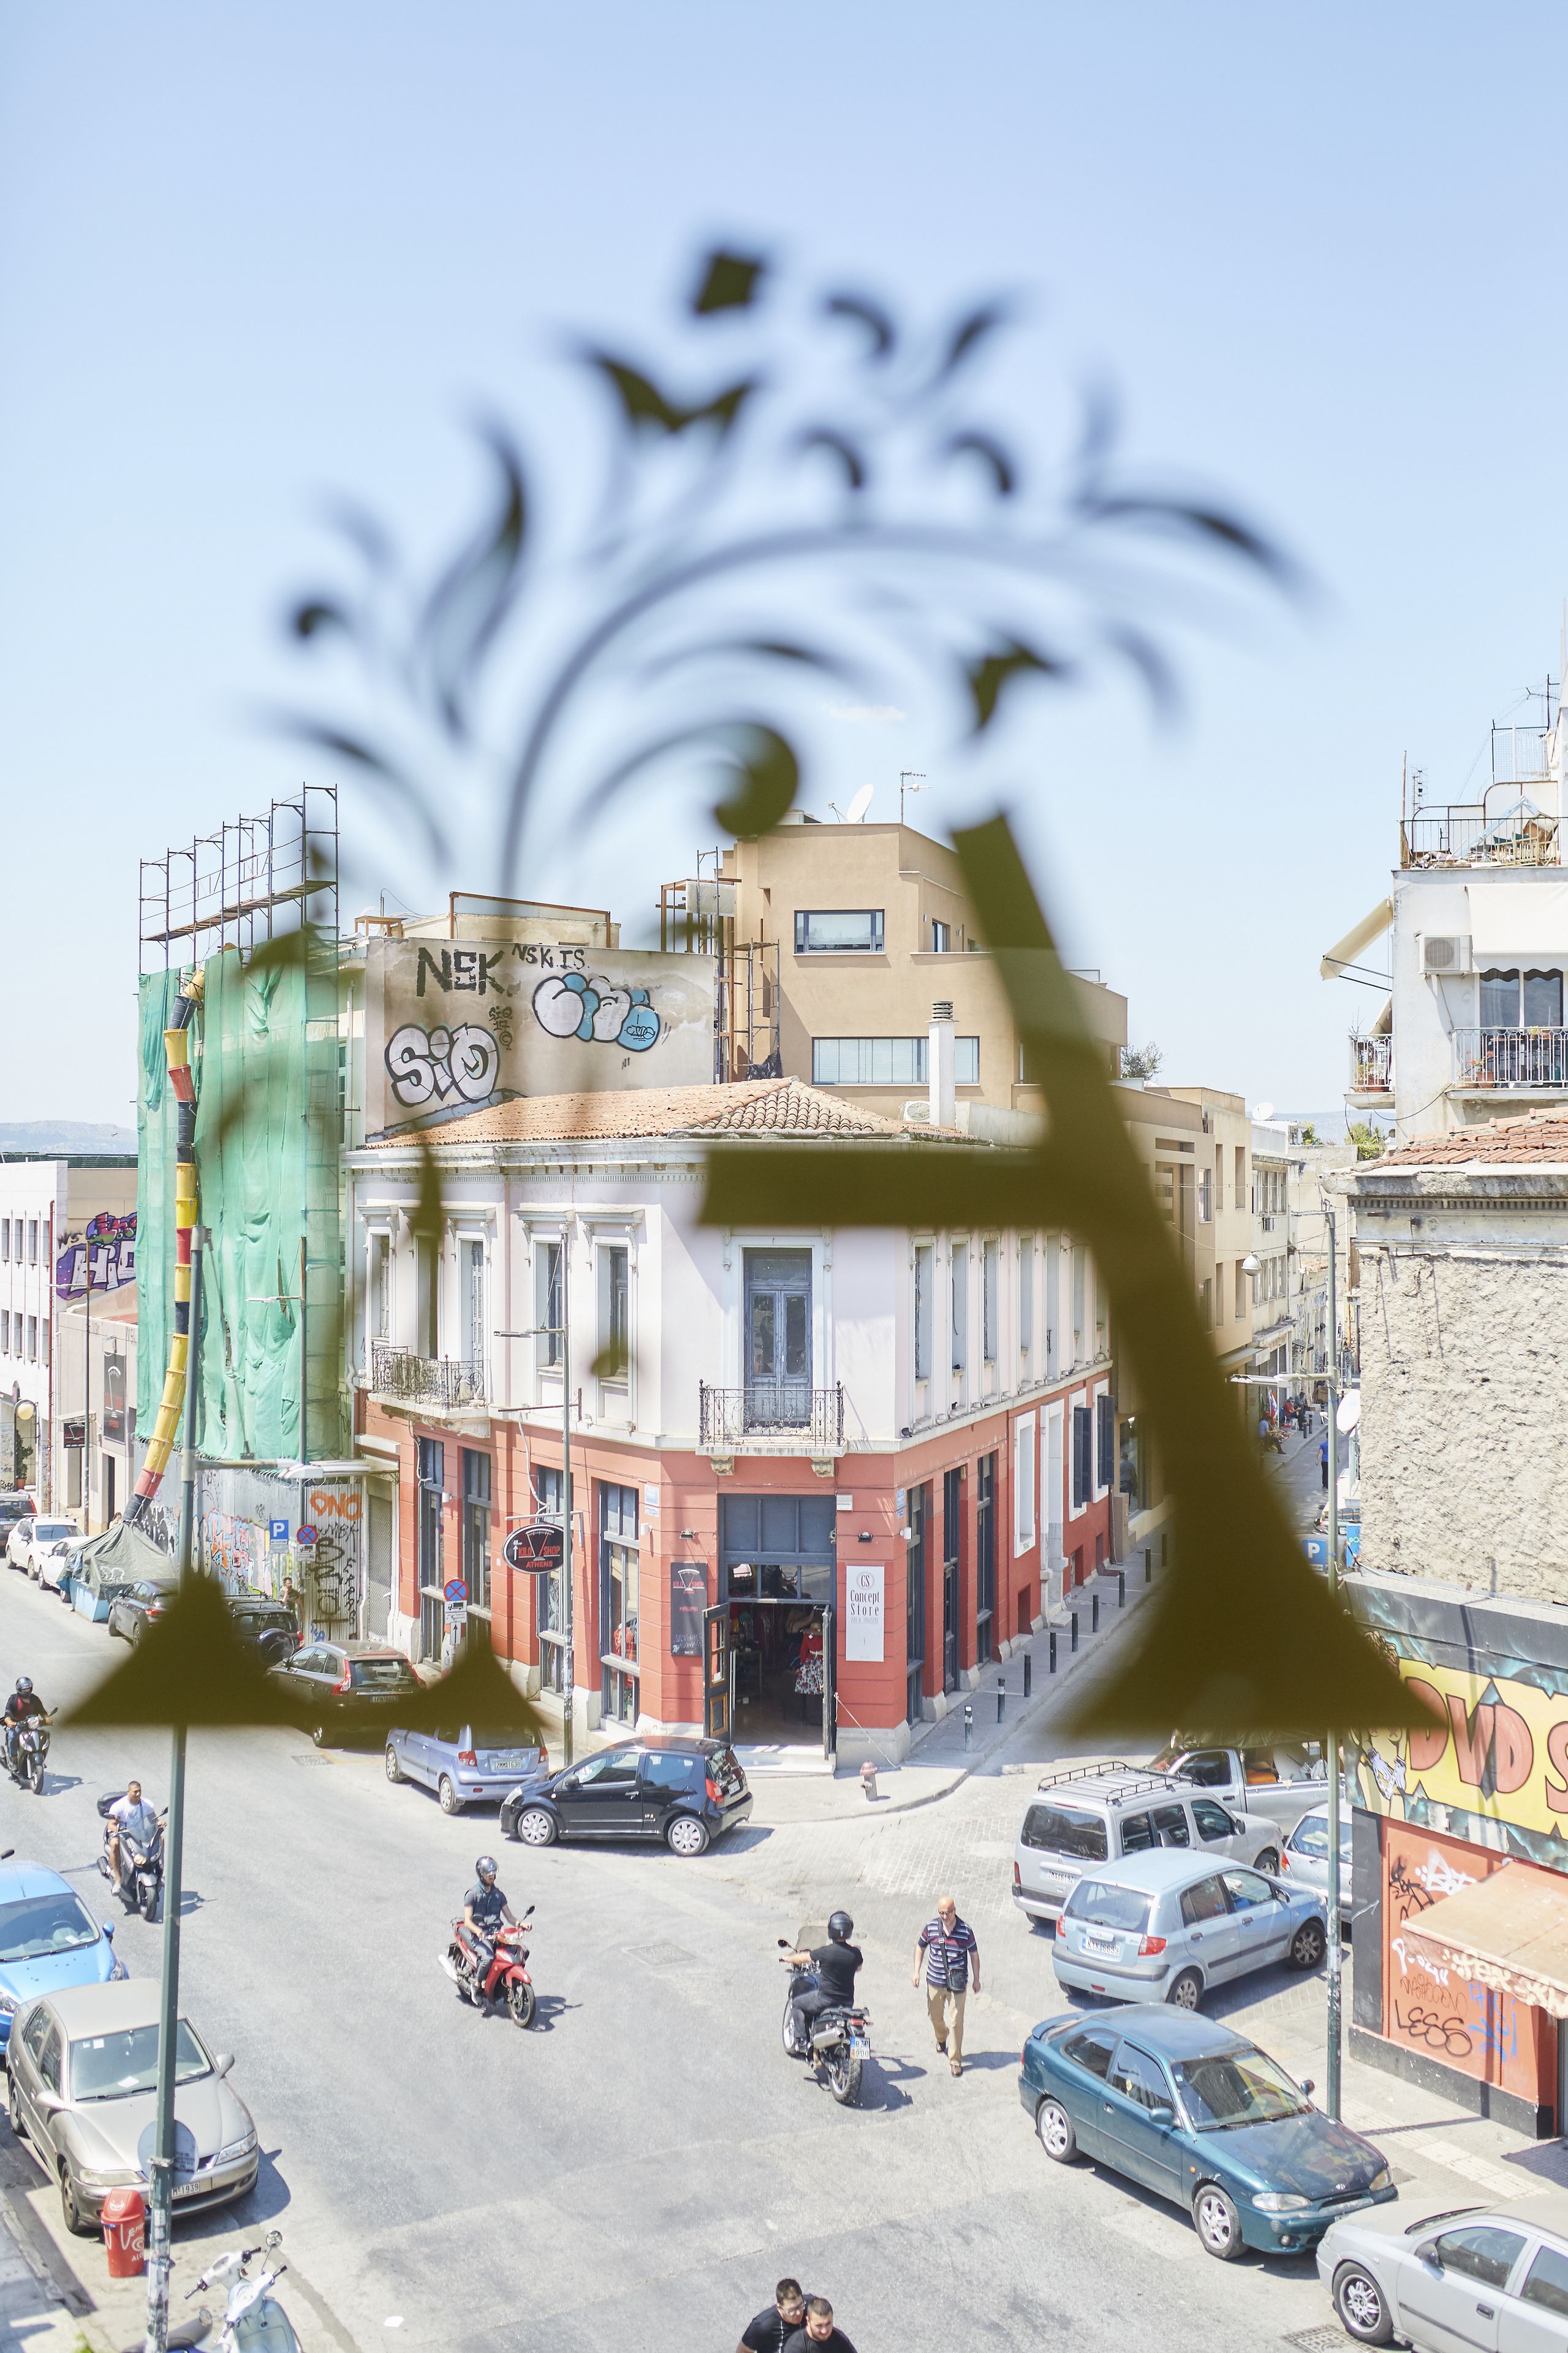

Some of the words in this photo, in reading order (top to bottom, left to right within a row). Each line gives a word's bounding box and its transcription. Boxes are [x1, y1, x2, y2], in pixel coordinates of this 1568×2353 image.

[273, 1523, 285, 1537] P
[518, 1547, 532, 1556] KILO
[543, 1545, 561, 1555] SHOP
[1308, 1542, 1320, 1558] P
[850, 1590, 880, 1605] Concept
[850, 1603, 879, 1616] Store
[182, 2183, 199, 2194] 1939
